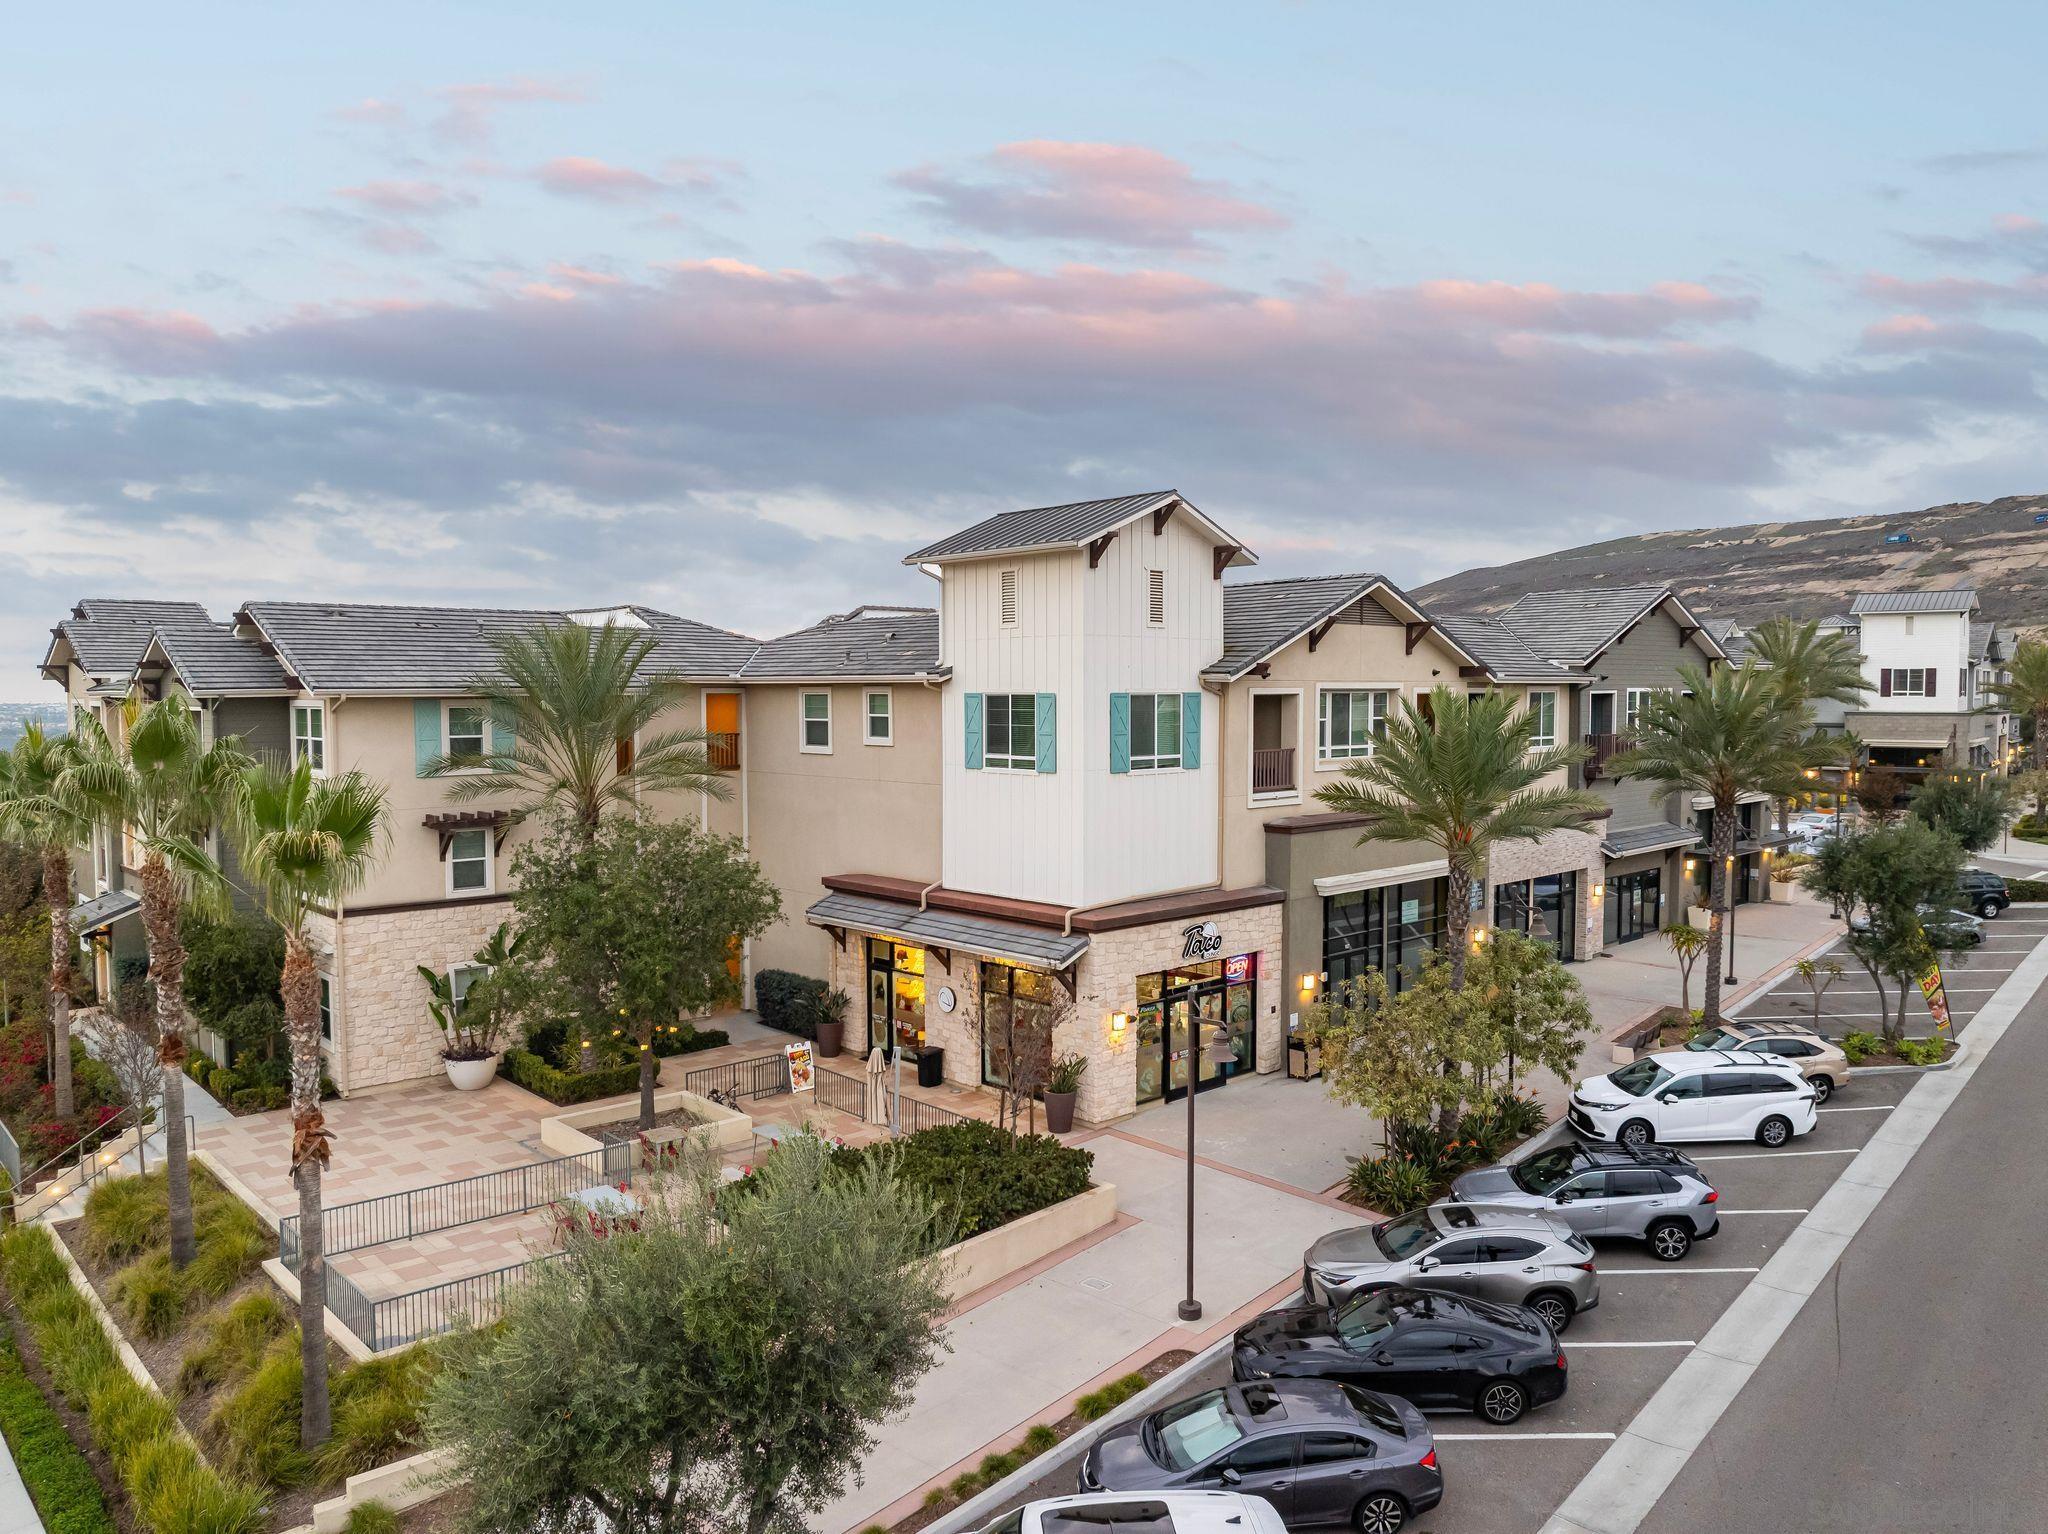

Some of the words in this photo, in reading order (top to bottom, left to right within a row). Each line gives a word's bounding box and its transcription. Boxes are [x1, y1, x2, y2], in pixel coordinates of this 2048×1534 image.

[1183, 924, 1222, 958] Taco
[1226, 958, 1248, 975] OPEN
[1923, 974, 1939, 991] DAY
